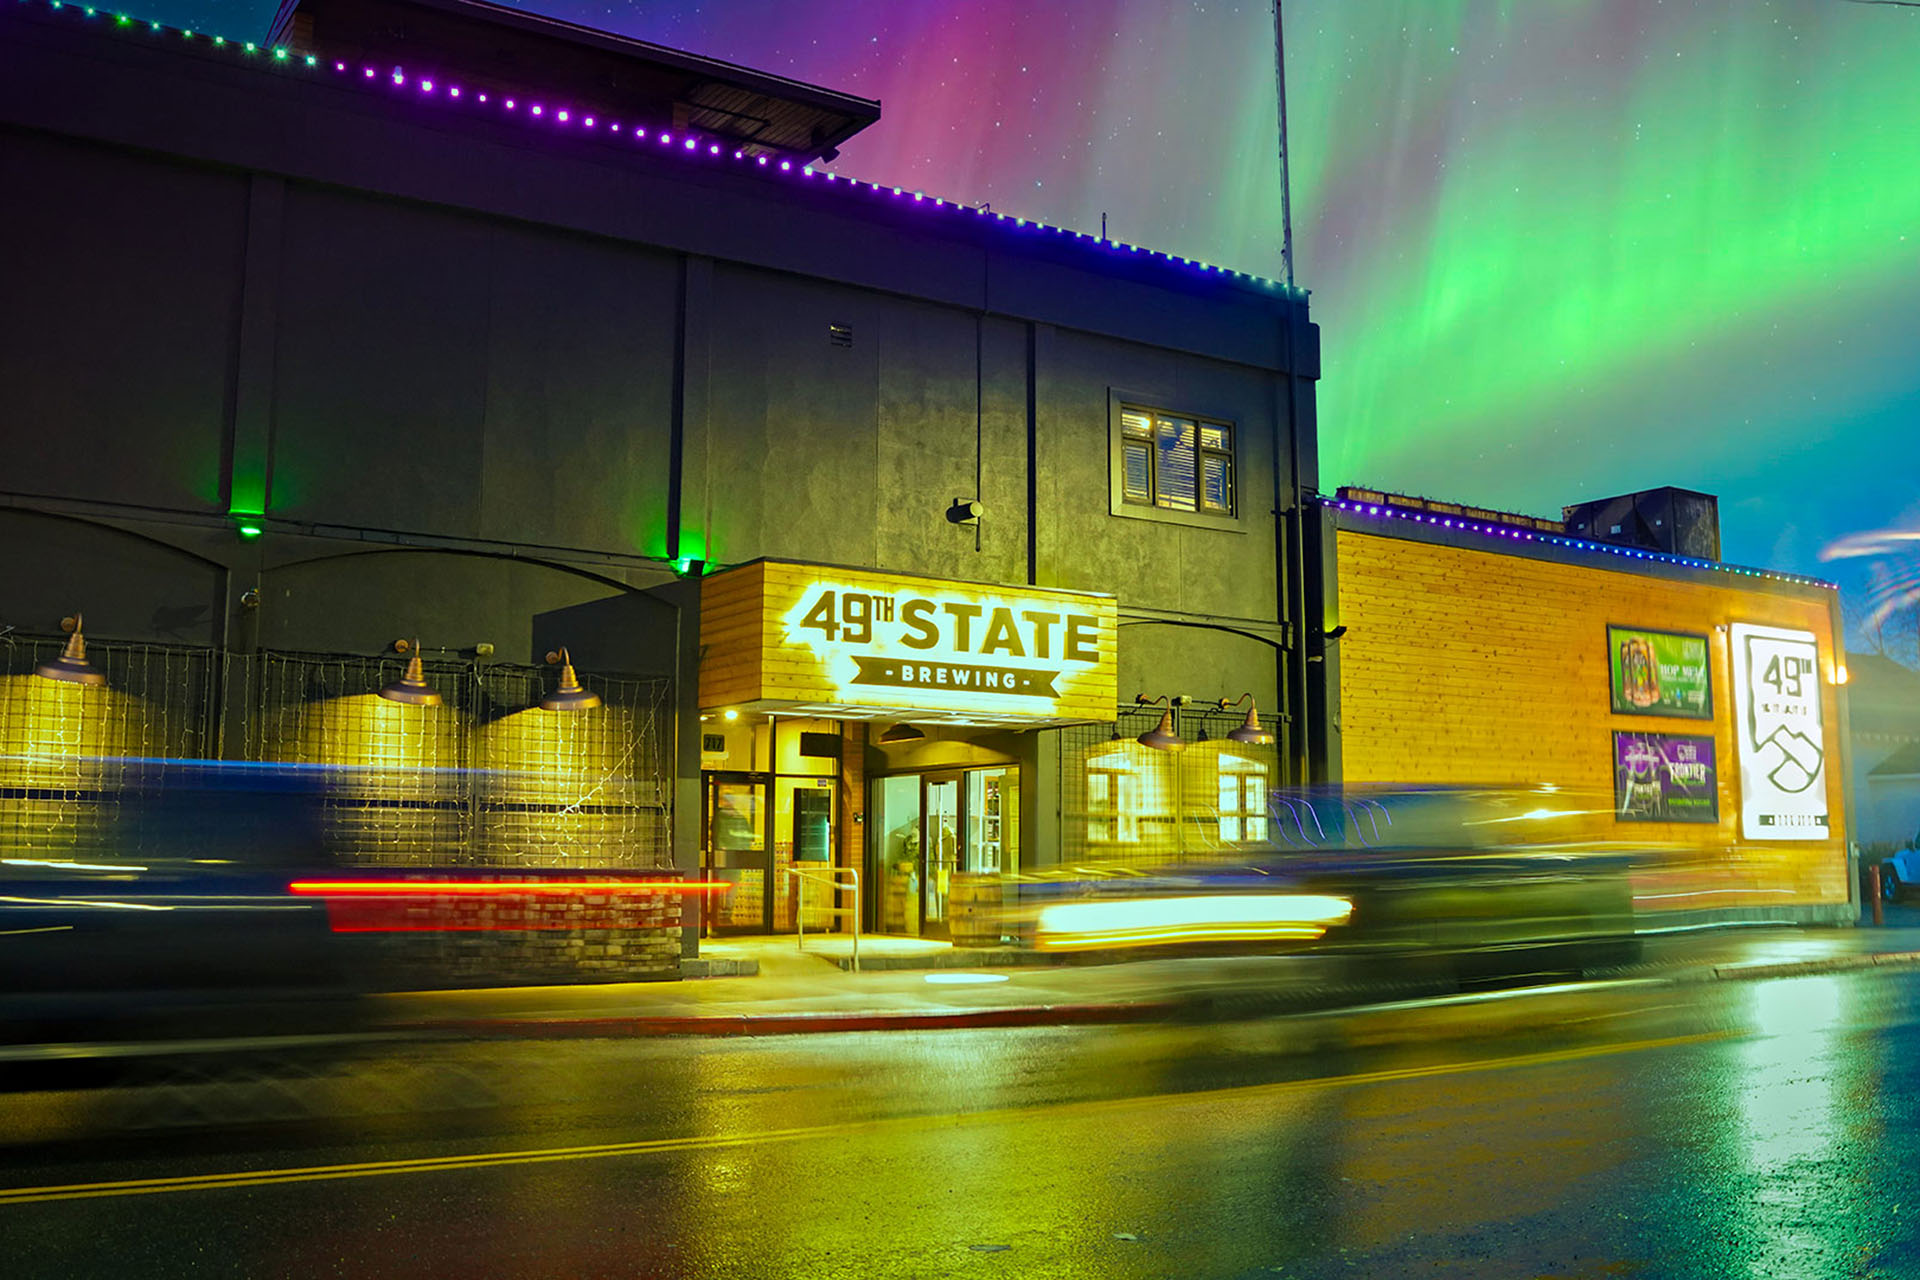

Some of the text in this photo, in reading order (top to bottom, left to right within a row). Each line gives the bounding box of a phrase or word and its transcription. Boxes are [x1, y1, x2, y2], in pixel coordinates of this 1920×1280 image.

[801, 590, 1099, 663] 49TH STATE
[902, 664, 1016, 689] BREWING
